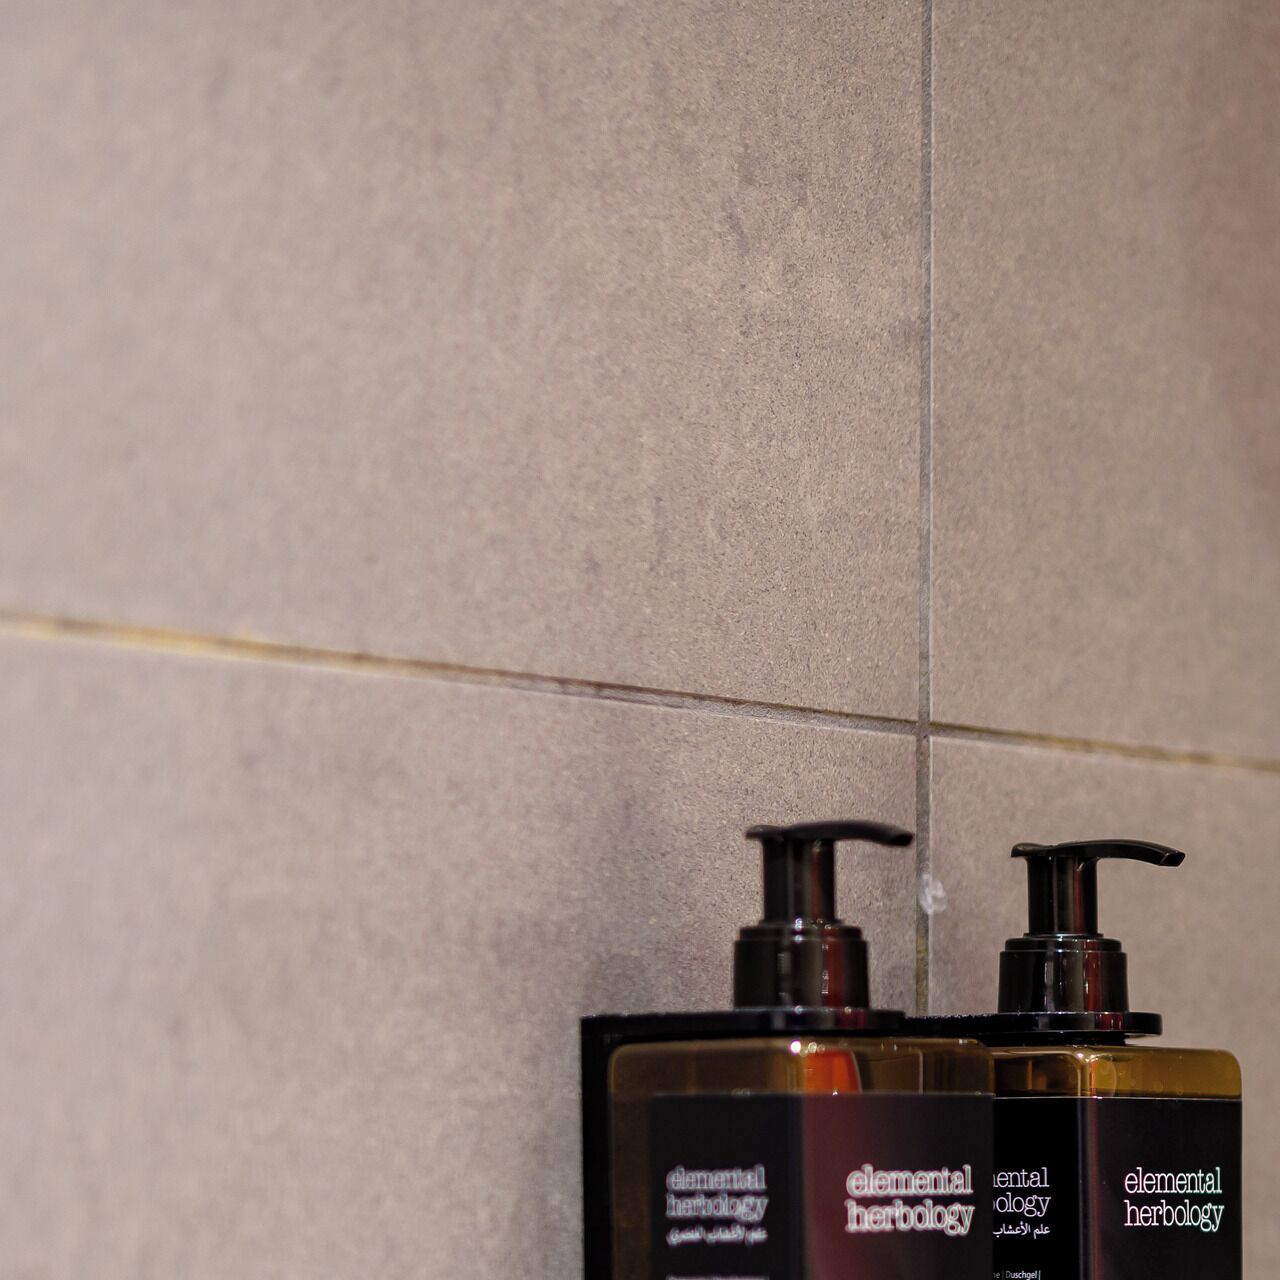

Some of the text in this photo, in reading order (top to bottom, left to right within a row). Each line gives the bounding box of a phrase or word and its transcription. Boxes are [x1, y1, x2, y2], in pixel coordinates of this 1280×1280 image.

[666, 1164, 768, 1192] elemental
[846, 1163, 974, 1198] elemental
[993, 1166, 1050, 1188] ental
[1124, 1166, 1223, 1194] elemental
[666, 1191, 769, 1223] herbology
[844, 1198, 976, 1236] herbology
[993, 1191, 1052, 1218] ology
[1123, 1199, 1225, 1233] herbology
